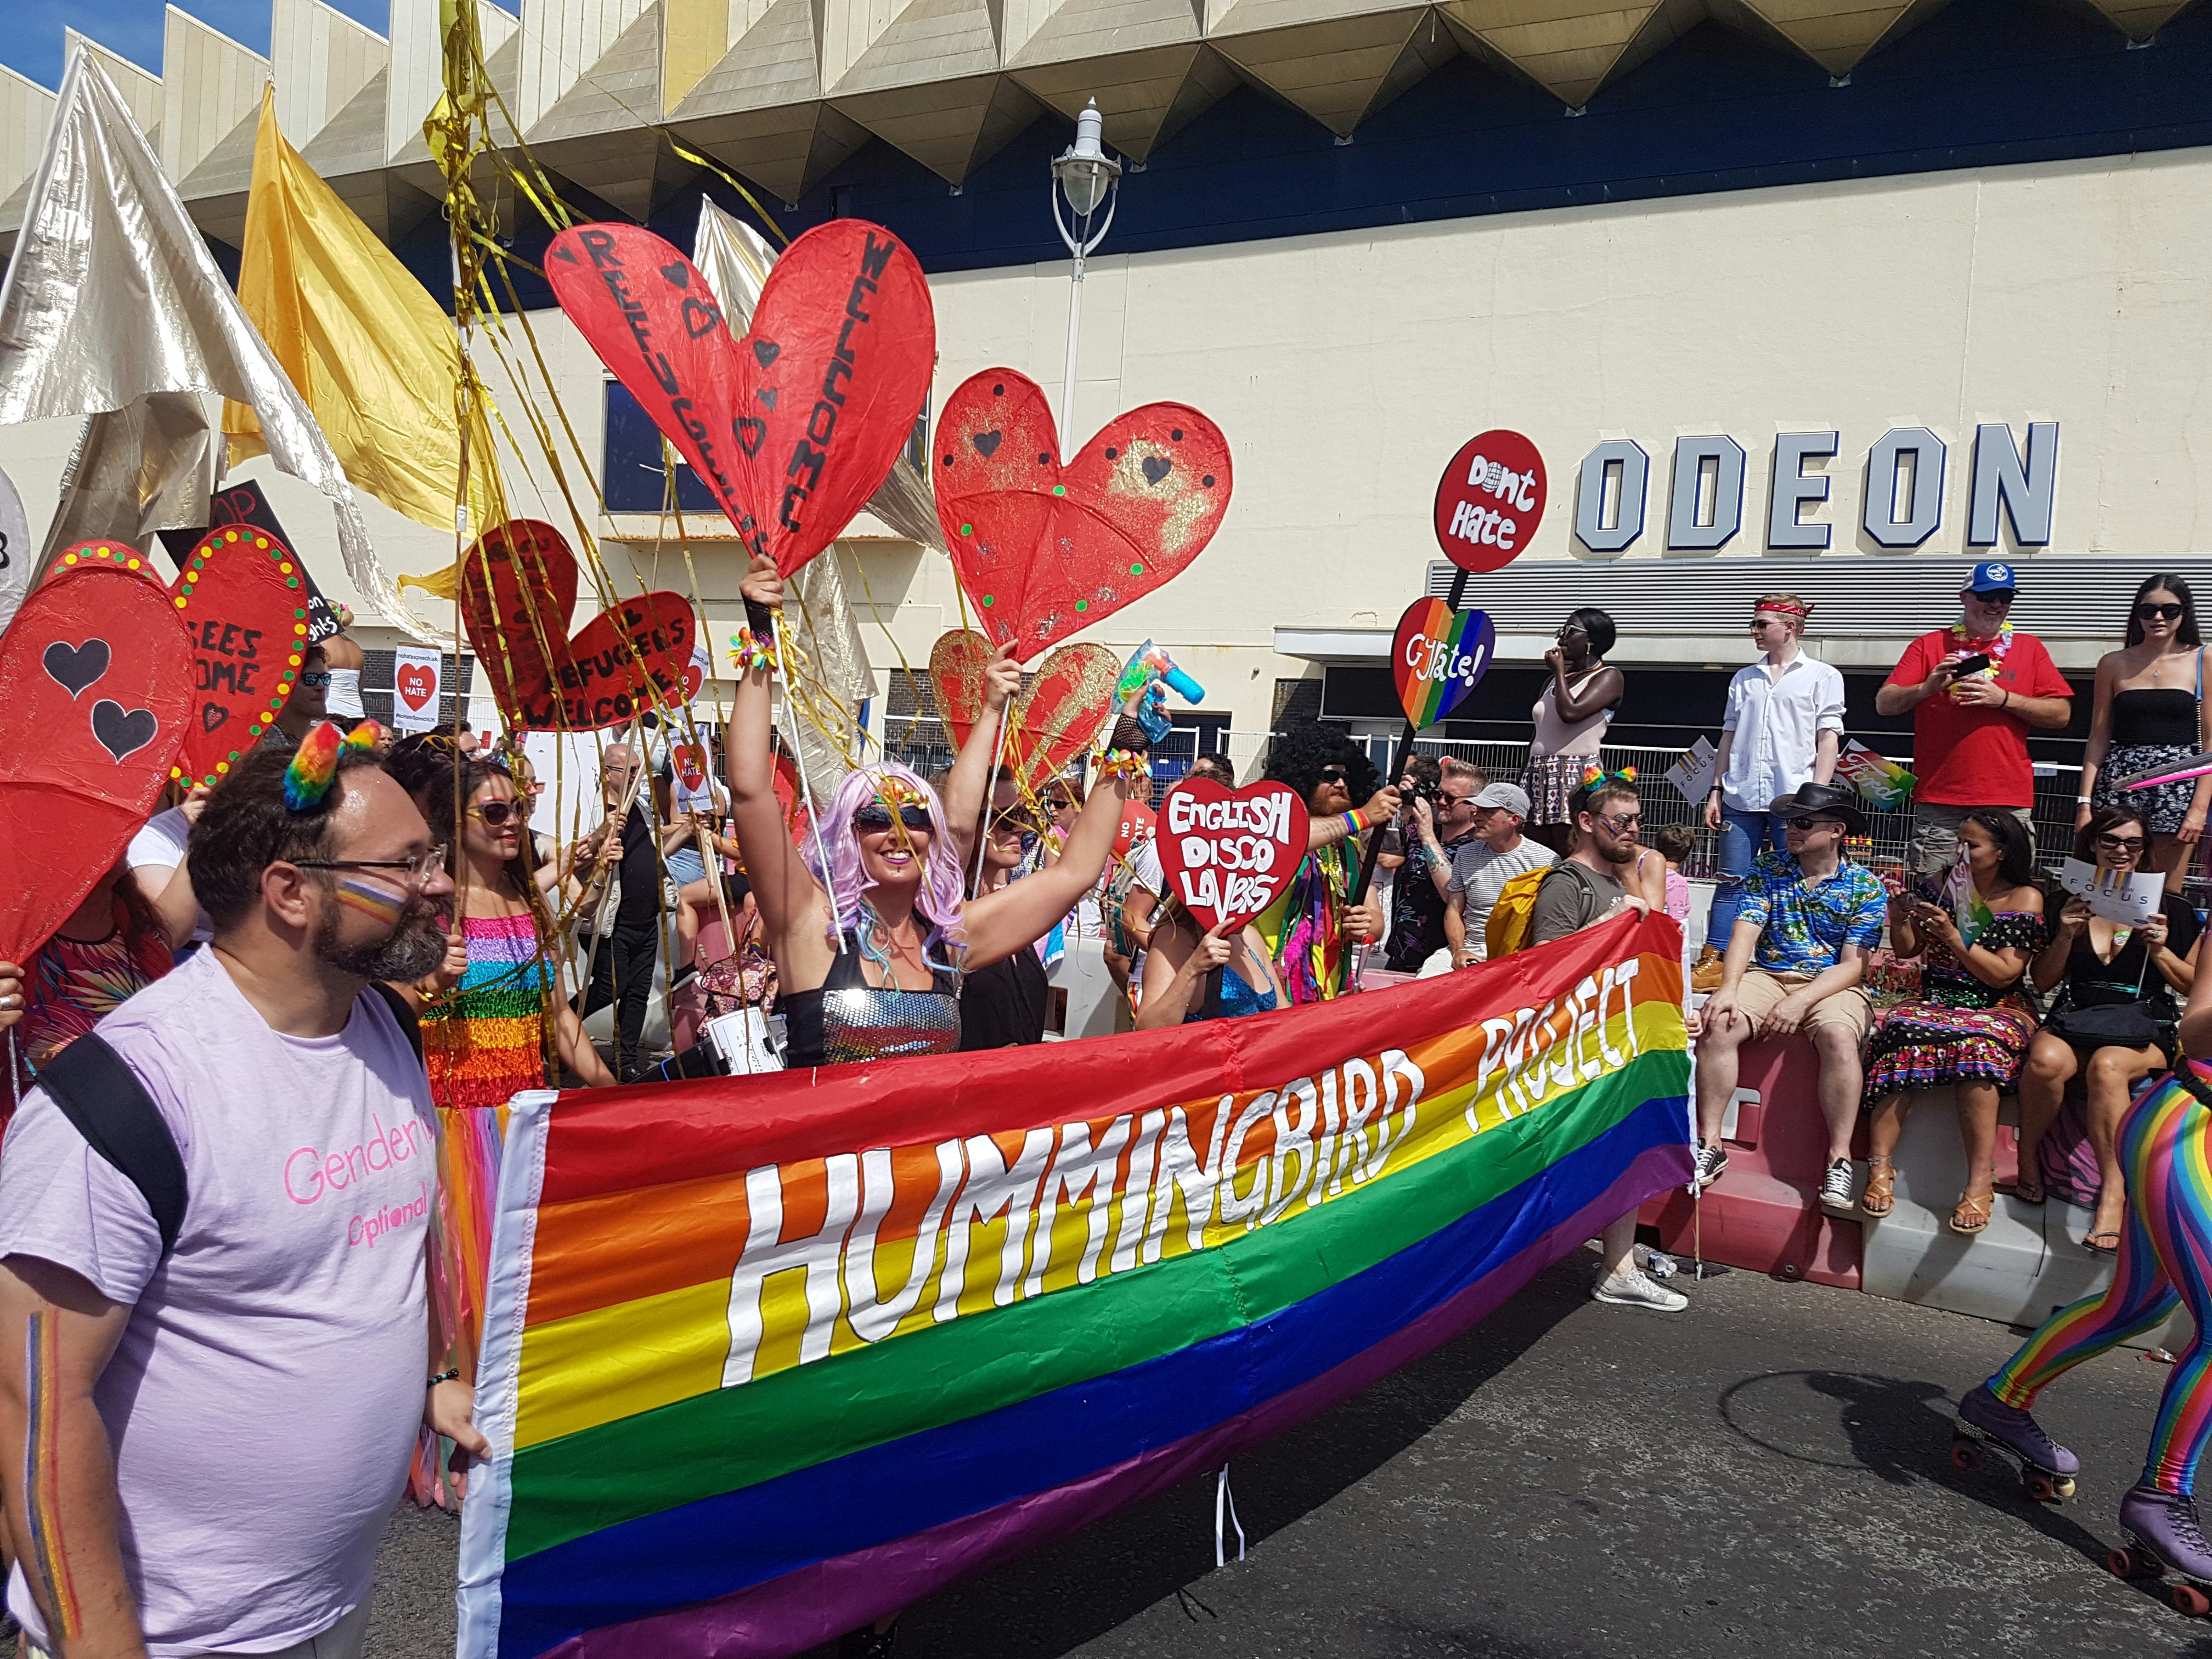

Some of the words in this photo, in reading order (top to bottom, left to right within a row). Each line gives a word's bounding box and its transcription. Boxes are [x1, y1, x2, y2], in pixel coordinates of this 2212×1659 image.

[779, 230, 898, 533] WELCOME
[1575, 421, 2059, 552] ODEON
[1448, 500, 1517, 550] Hate
[398, 653, 438, 662] nohatespeech.uk
[405, 687, 427, 697] HATE
[409, 677, 422, 686] NO
[681, 767, 701, 777] HATE
[1680, 754, 1714, 788] FOCUS
[1836, 753, 1903, 801] Ford
[1121, 822, 1130, 838] NO
[1135, 817, 1145, 836] ATE
[1181, 835, 1275, 873] DISCO
[2070, 878, 2149, 905] FOCUS
[284, 1113, 417, 1205] Gender
[719, 1048, 1425, 1389] HUMMINGBIRD
[1465, 957, 1640, 1134] PROJECT
